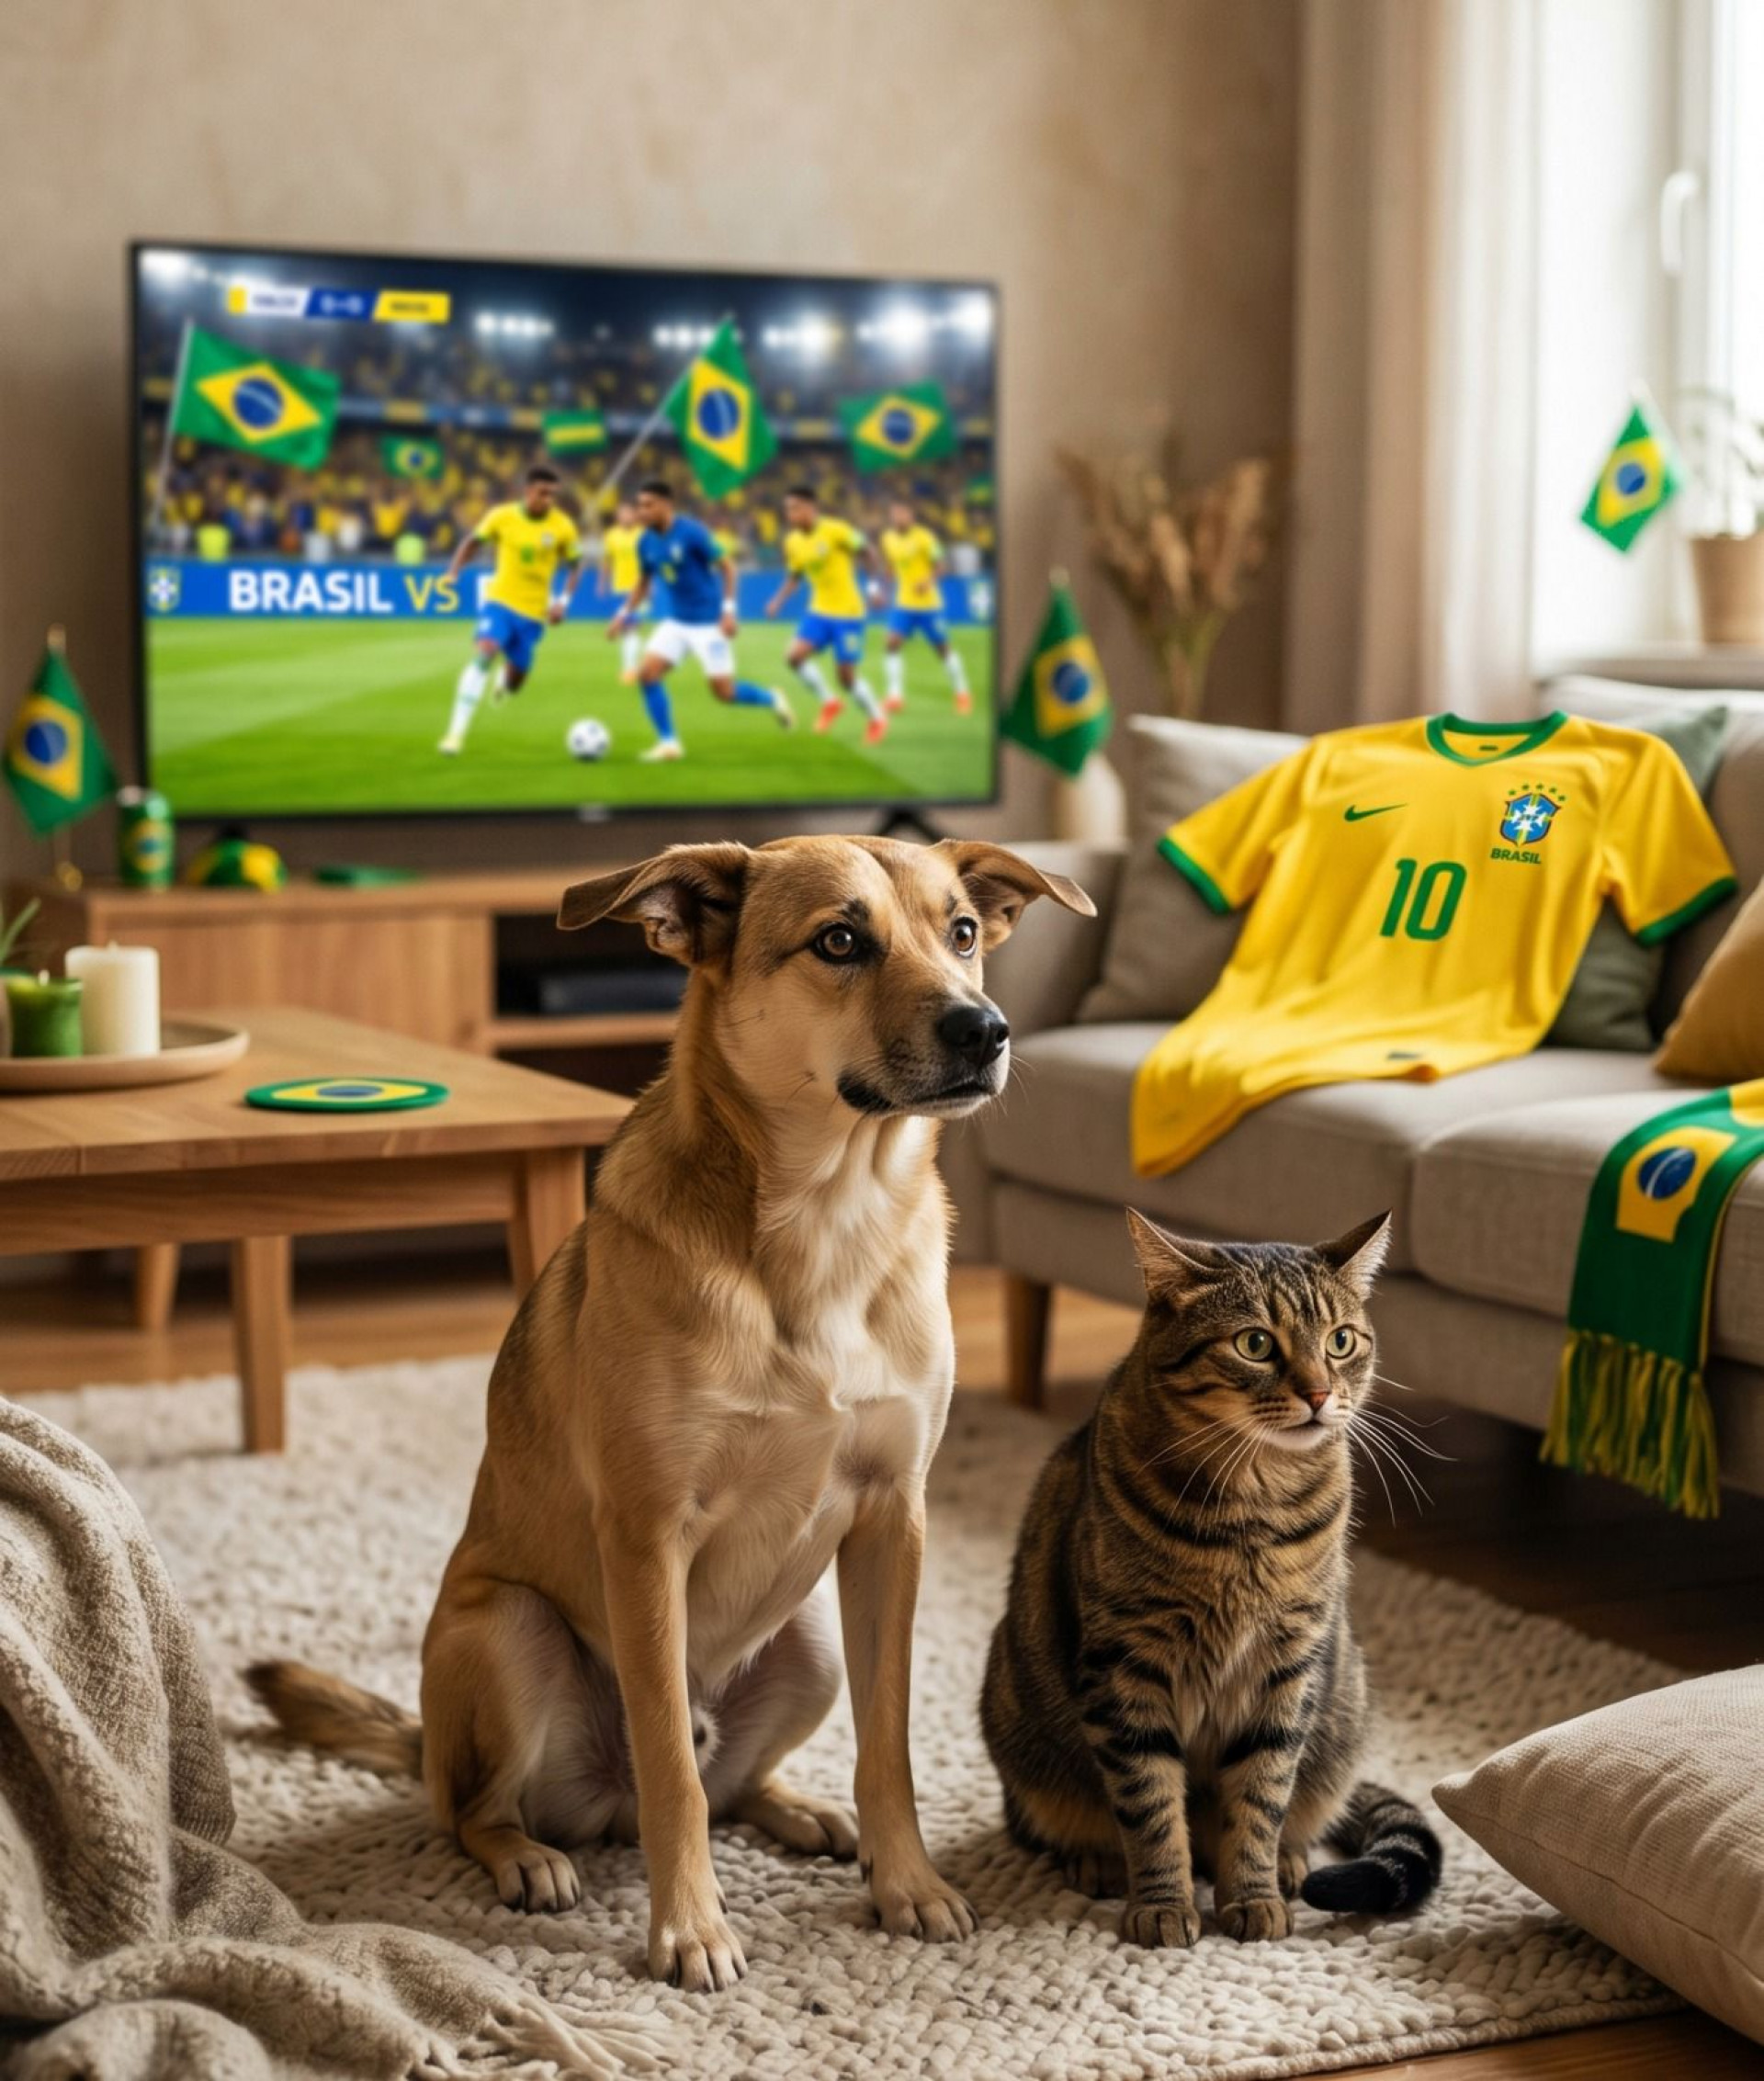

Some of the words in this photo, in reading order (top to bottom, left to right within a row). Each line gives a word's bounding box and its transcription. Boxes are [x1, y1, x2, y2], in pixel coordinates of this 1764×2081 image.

[229, 570, 393, 612] BRASIL
[404, 574, 458, 612] VS
[1490, 847, 1542, 865] BRASIL
[1380, 857, 1467, 941] 10
